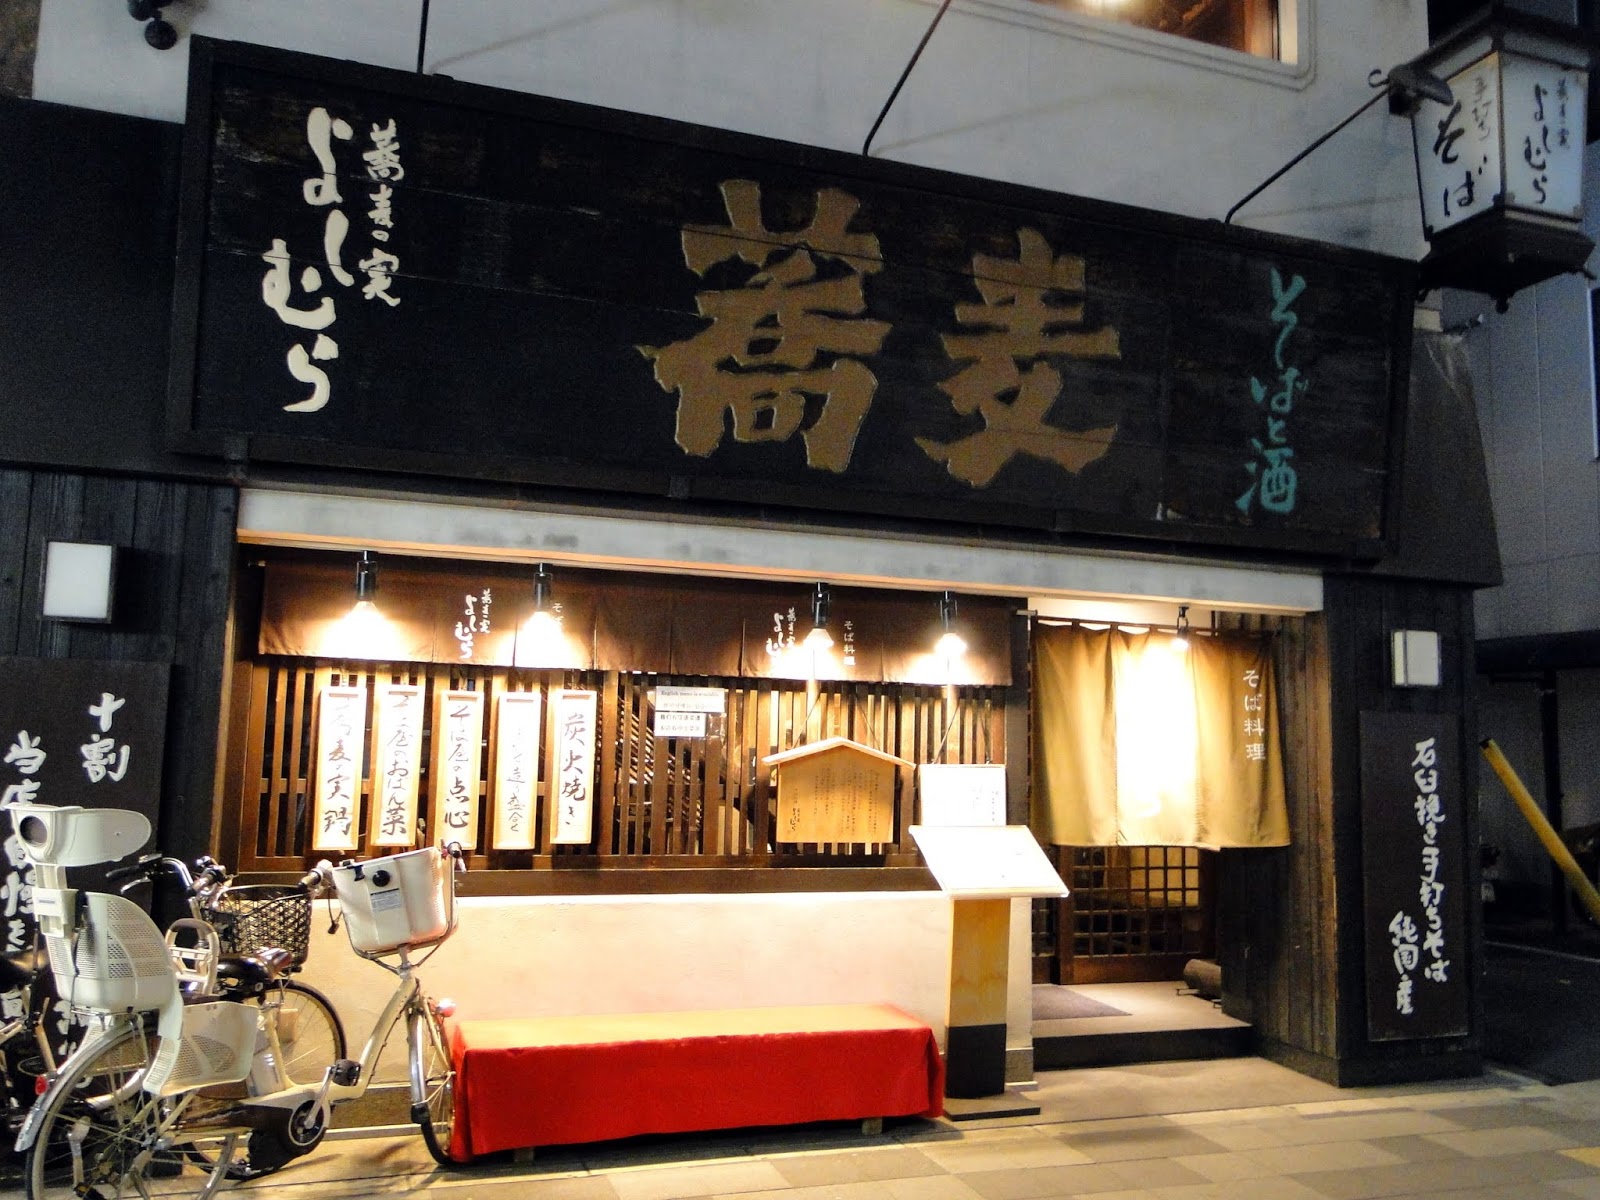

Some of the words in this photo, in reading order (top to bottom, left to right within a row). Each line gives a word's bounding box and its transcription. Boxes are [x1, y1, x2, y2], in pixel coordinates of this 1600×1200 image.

[1433, 101, 1489, 217] そば
[1524, 83, 1552, 204] よしむら
[262, 107, 354, 412] よしむら
[358, 118, 404, 307] 蕎麦の実
[635, 179, 1121, 489] 蕎麦
[454, 594, 478, 659] よしむら
[563, 713, 586, 826] 炭火焼き
[1243, 669, 1266, 760] そば料理
[1411, 737, 1450, 982] 石臼挽き手打ちそば
[1388, 910, 1420, 1015] 純国産
